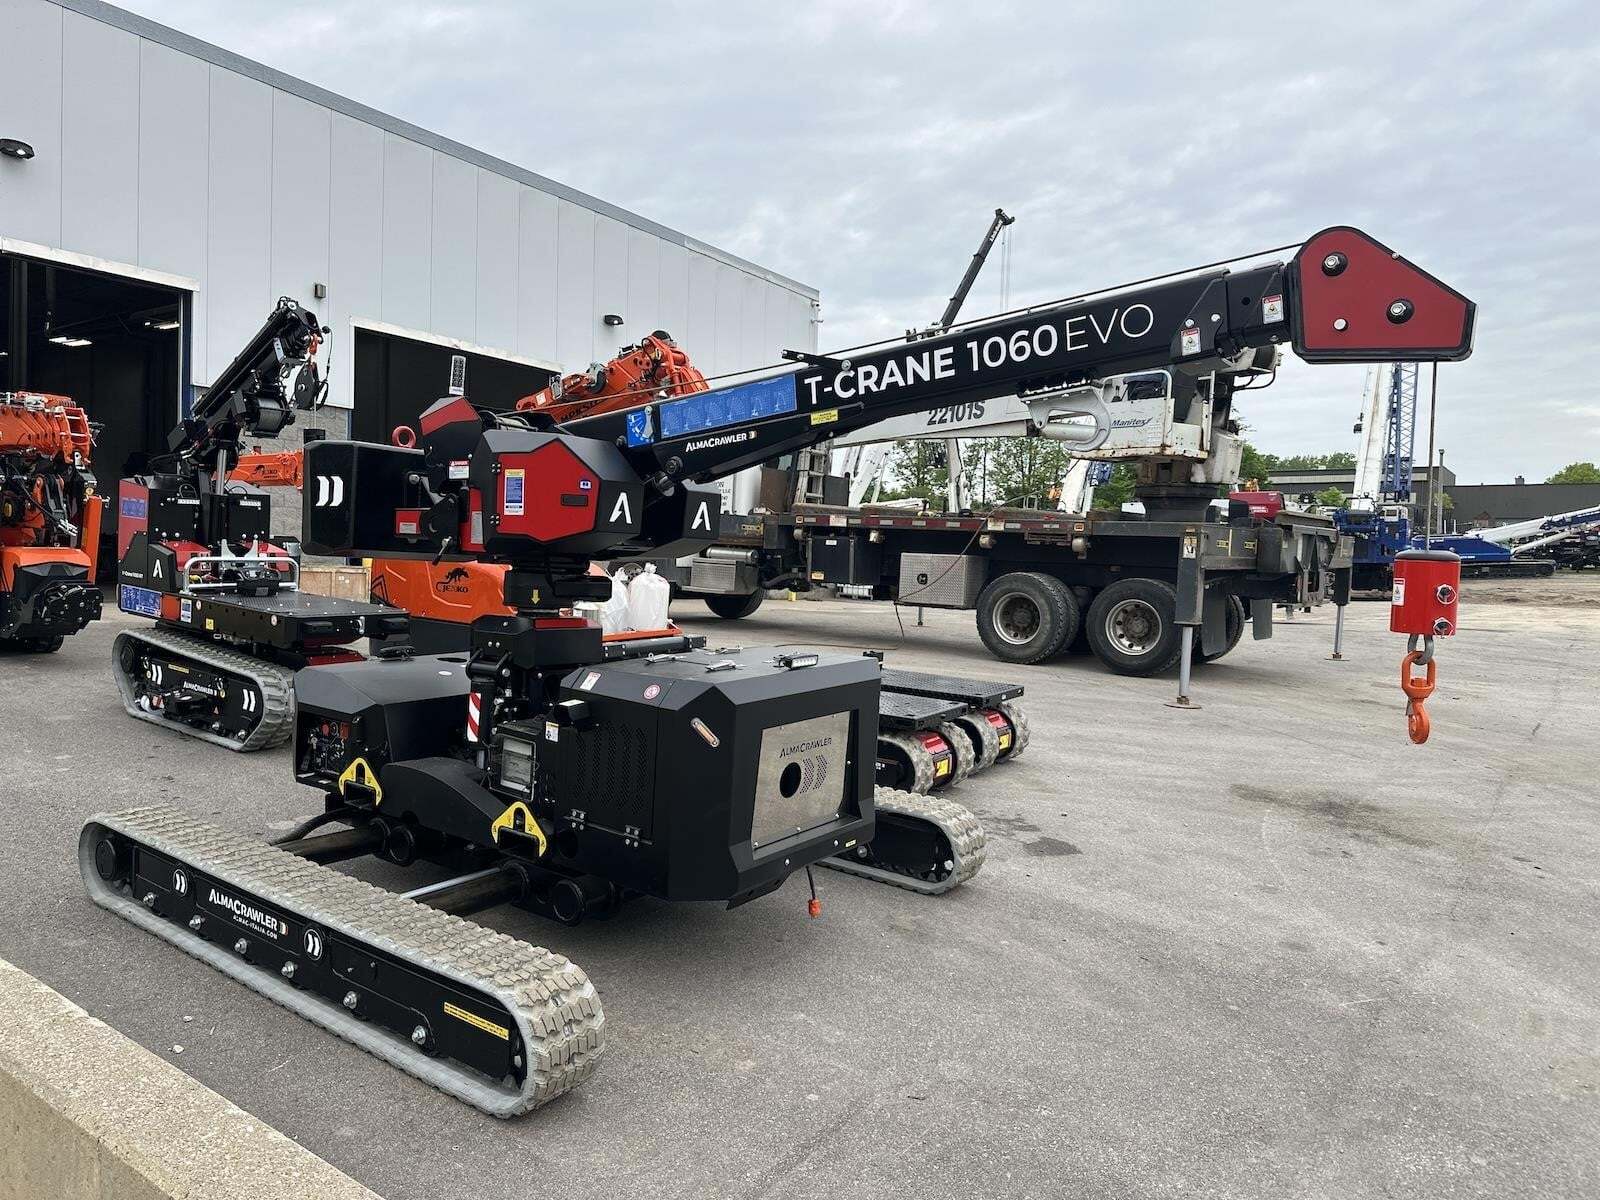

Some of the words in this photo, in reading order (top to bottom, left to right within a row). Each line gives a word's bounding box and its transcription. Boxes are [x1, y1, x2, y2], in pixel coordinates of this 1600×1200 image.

[804, 346, 955, 404] T-CRANE
[966, 325, 1058, 371] 1060
[1066, 304, 1155, 351] EVO
[927, 400, 986, 426] 22101S
[685, 432, 748, 452] ALMACRAWLER
[779, 737, 832, 759] ALMACRAWLER
[208, 888, 278, 932] ALMACRAWLER
